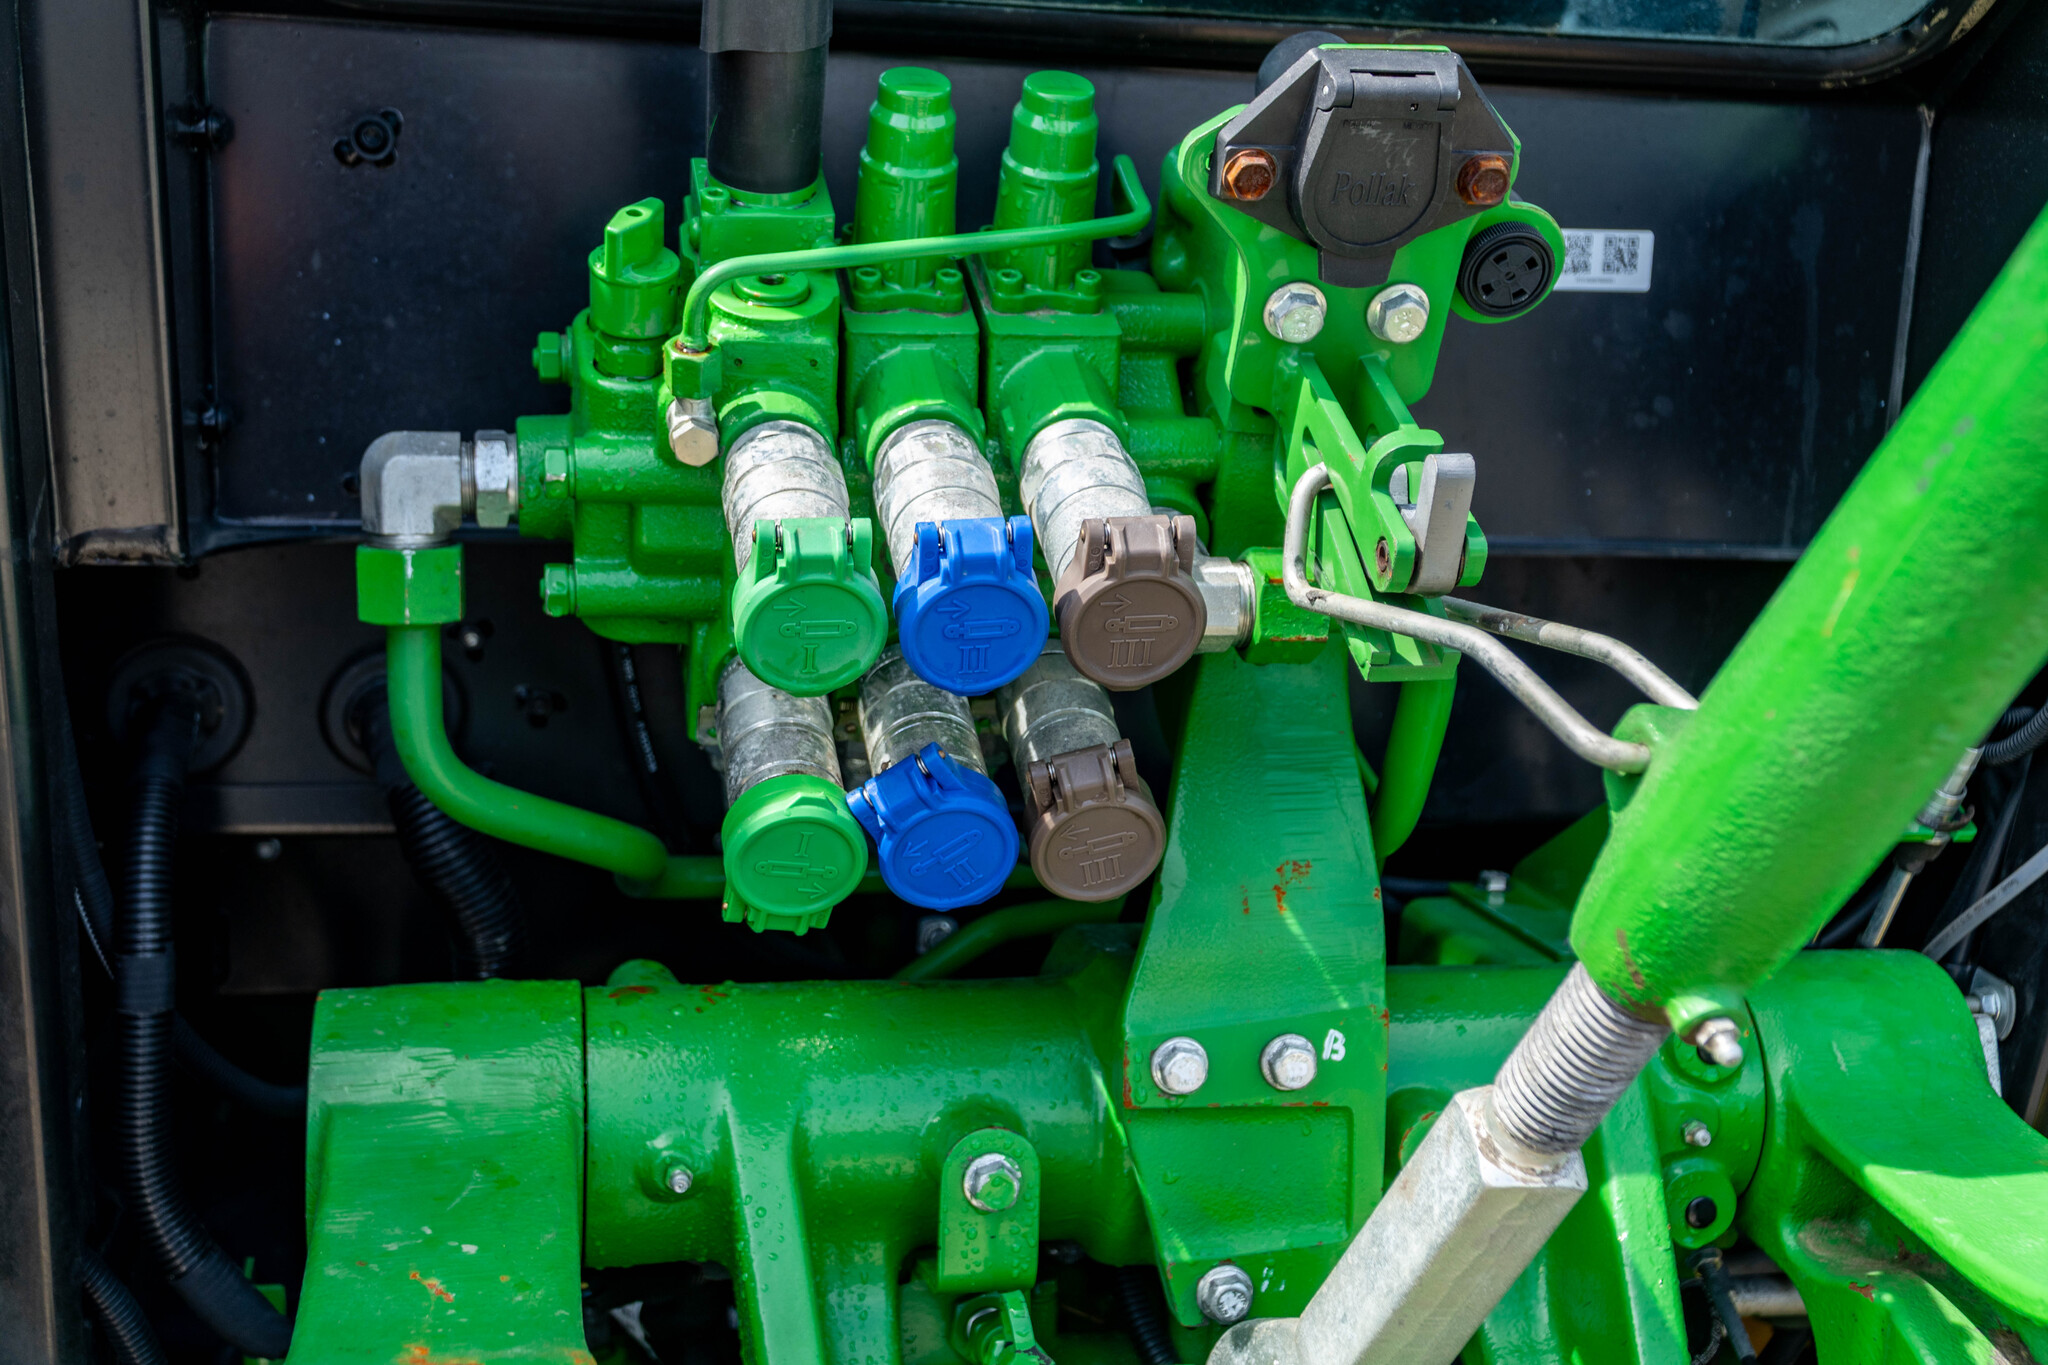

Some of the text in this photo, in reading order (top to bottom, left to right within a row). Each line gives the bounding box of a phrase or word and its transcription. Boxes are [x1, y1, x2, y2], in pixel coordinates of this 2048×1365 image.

[1331, 170, 1416, 206] Pollak
[802, 644, 819, 673] I
[959, 644, 991, 675] II
[1106, 638, 1156, 669] III
[795, 831, 814, 857] I
[944, 857, 983, 889] II
[1079, 853, 1125, 888] III
